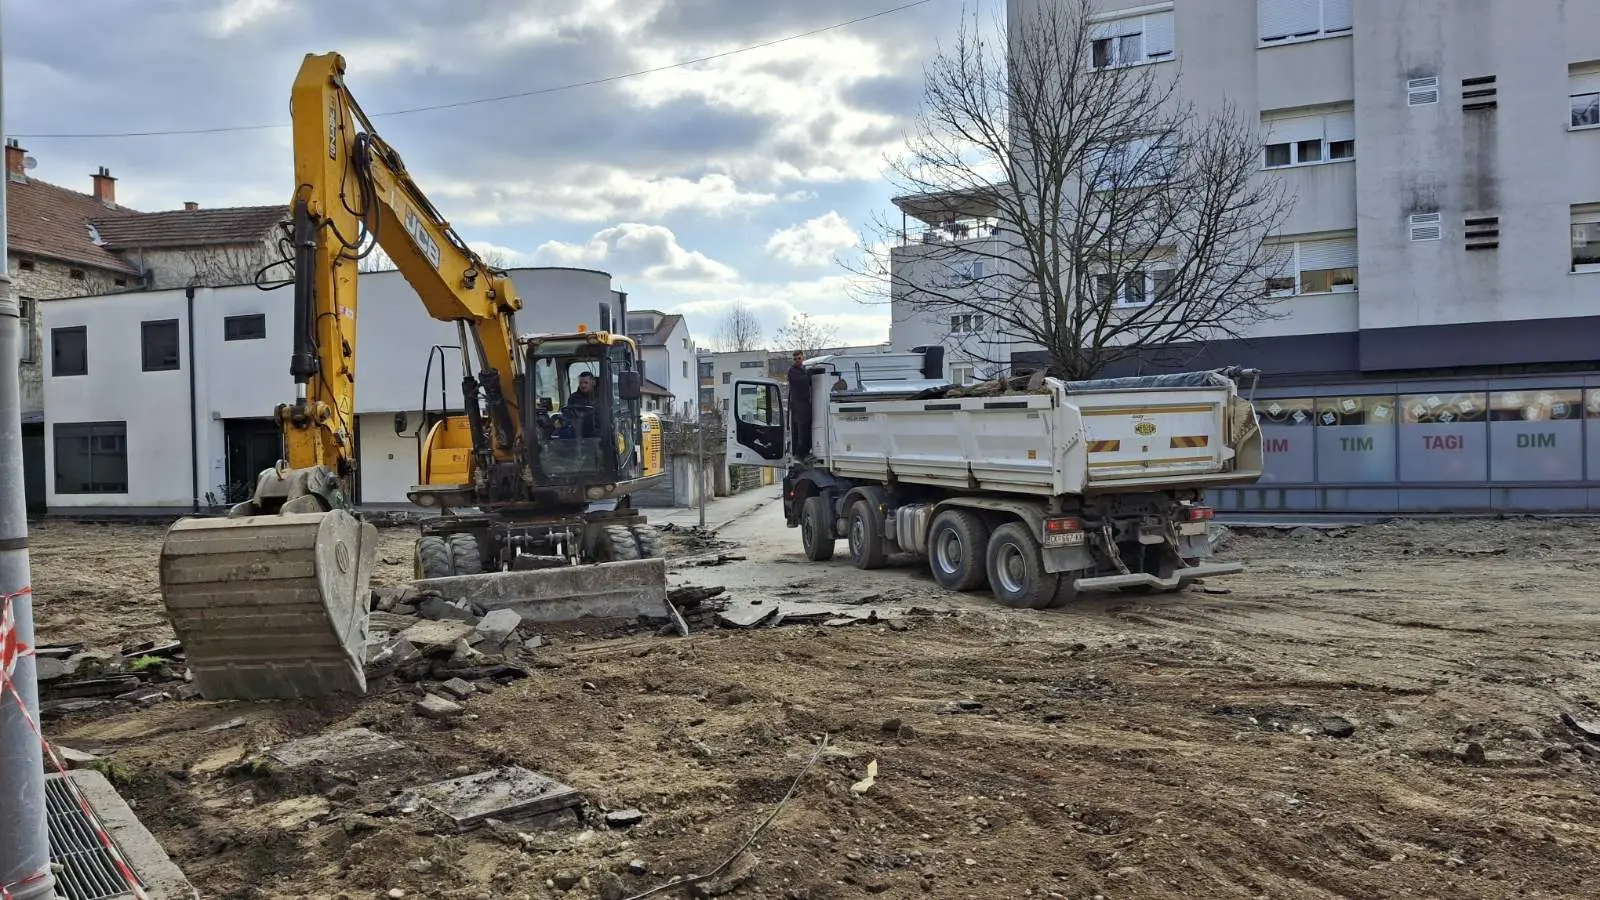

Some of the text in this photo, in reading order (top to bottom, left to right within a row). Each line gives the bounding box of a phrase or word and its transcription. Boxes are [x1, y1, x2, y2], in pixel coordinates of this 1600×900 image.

[405, 208, 440, 269] JCB
[1263, 433, 1556, 453] IM TIM TAGI DIM
